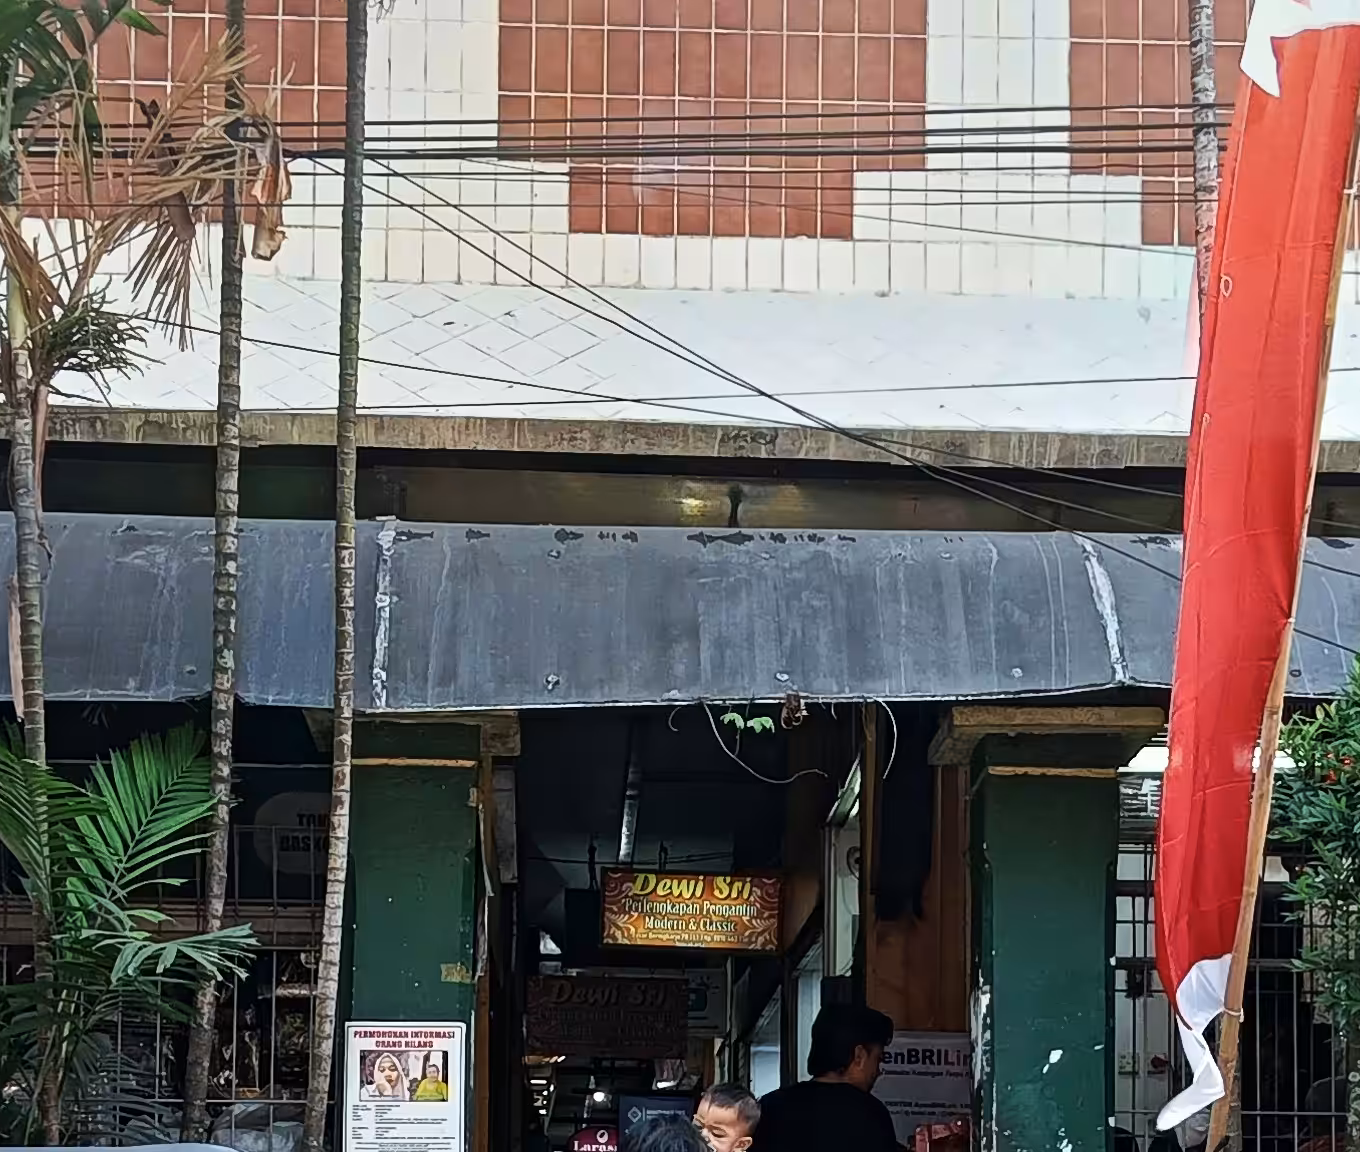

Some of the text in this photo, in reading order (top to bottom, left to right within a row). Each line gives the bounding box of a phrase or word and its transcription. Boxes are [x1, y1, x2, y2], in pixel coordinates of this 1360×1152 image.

[632, 872, 752, 900] Dewi Sri
[625, 898, 757, 917] Perlengkapan Pengantin
[644, 915, 737, 932] Modern & Classic
[353, 1030, 455, 1039] PERMOHONAN INFORMASI
[375, 1040, 434, 1048] ORANG HILANG
[882, 1048, 970, 1067] enBRILi
